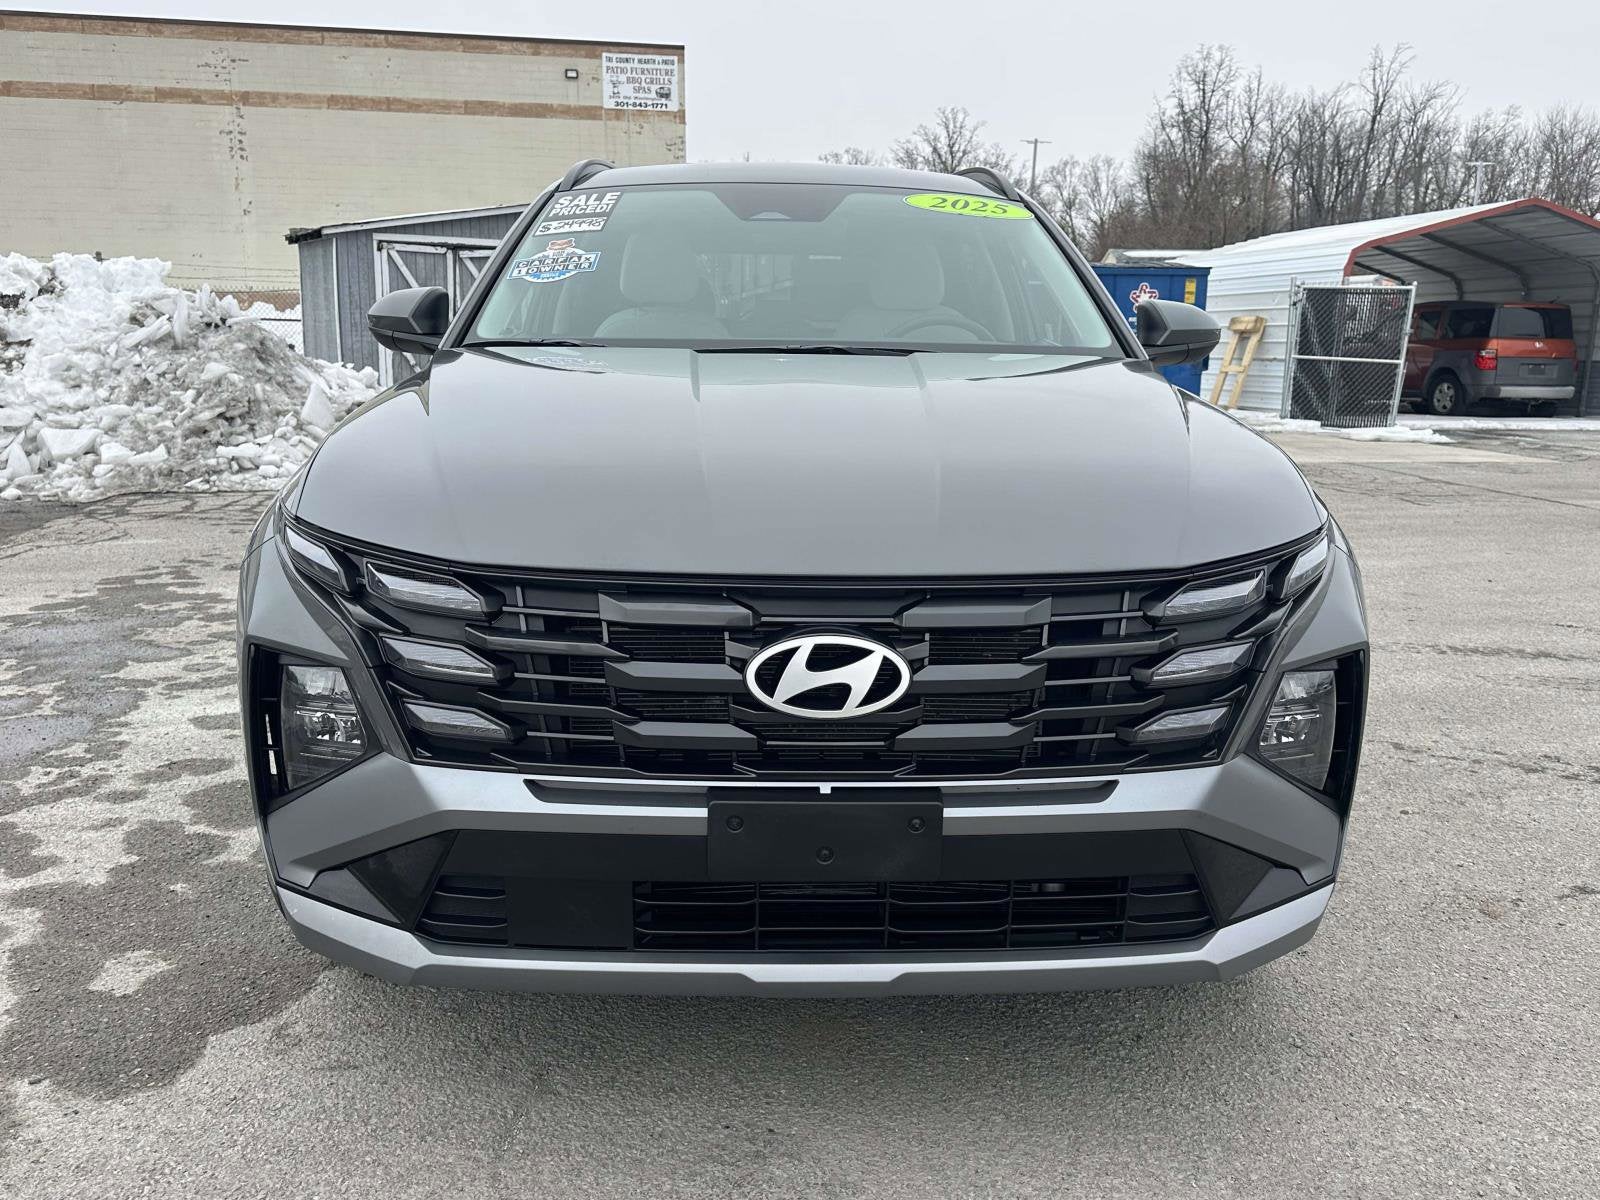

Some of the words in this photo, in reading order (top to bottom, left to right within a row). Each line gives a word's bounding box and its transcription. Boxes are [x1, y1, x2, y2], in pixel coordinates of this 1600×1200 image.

[605, 55, 613, 63] TRI
[615, 56, 635, 64] COUNTY
[637, 57, 656, 65] HEARTH
[606, 65, 628, 75] PATIO
[630, 66, 675, 77] FURNITURE
[626, 76, 642, 85] BBQ
[644, 77, 672, 86] GRILLS
[633, 85, 652, 94] SPAS
[614, 101, 668, 109] 301-843-1771
[554, 192, 621, 209] SALE
[929, 196, 1009, 215] 2025
[549, 203, 613, 217] PRICED!
[516, 255, 592, 268] CARFAX
[527, 262, 592, 275] OWNER
